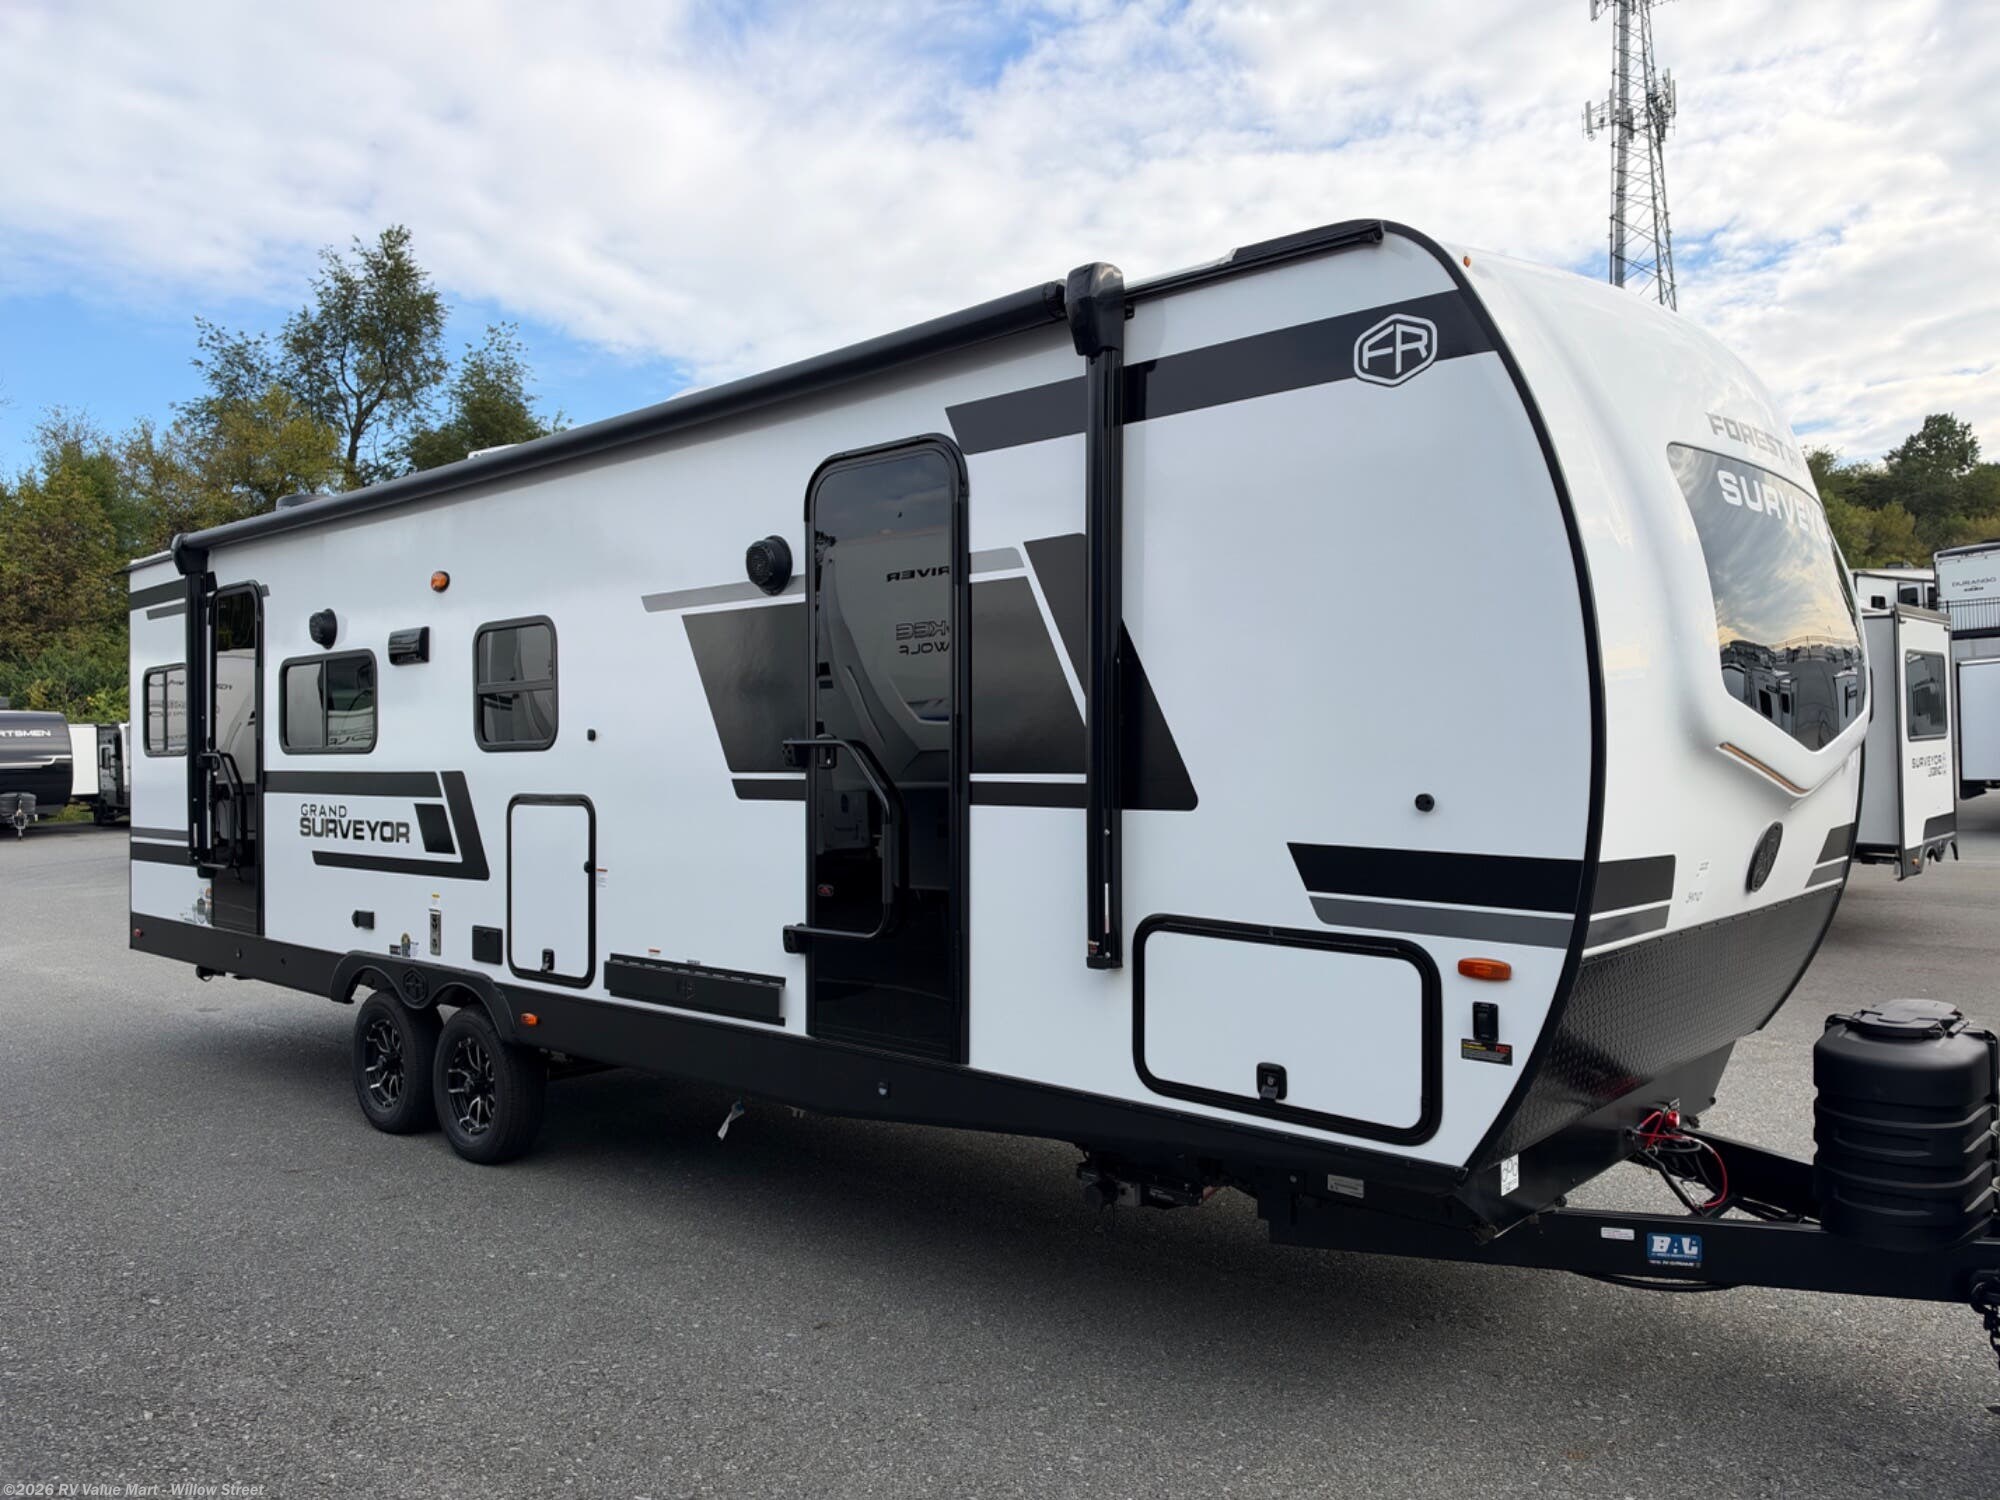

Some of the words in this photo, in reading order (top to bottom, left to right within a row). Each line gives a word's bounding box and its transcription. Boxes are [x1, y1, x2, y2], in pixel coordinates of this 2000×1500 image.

[1704, 411, 1786, 461] FOREST
[300, 803, 347, 818] GRAND
[300, 816, 411, 844] SURVEYOR
[1652, 1235, 1698, 1256] BAL
